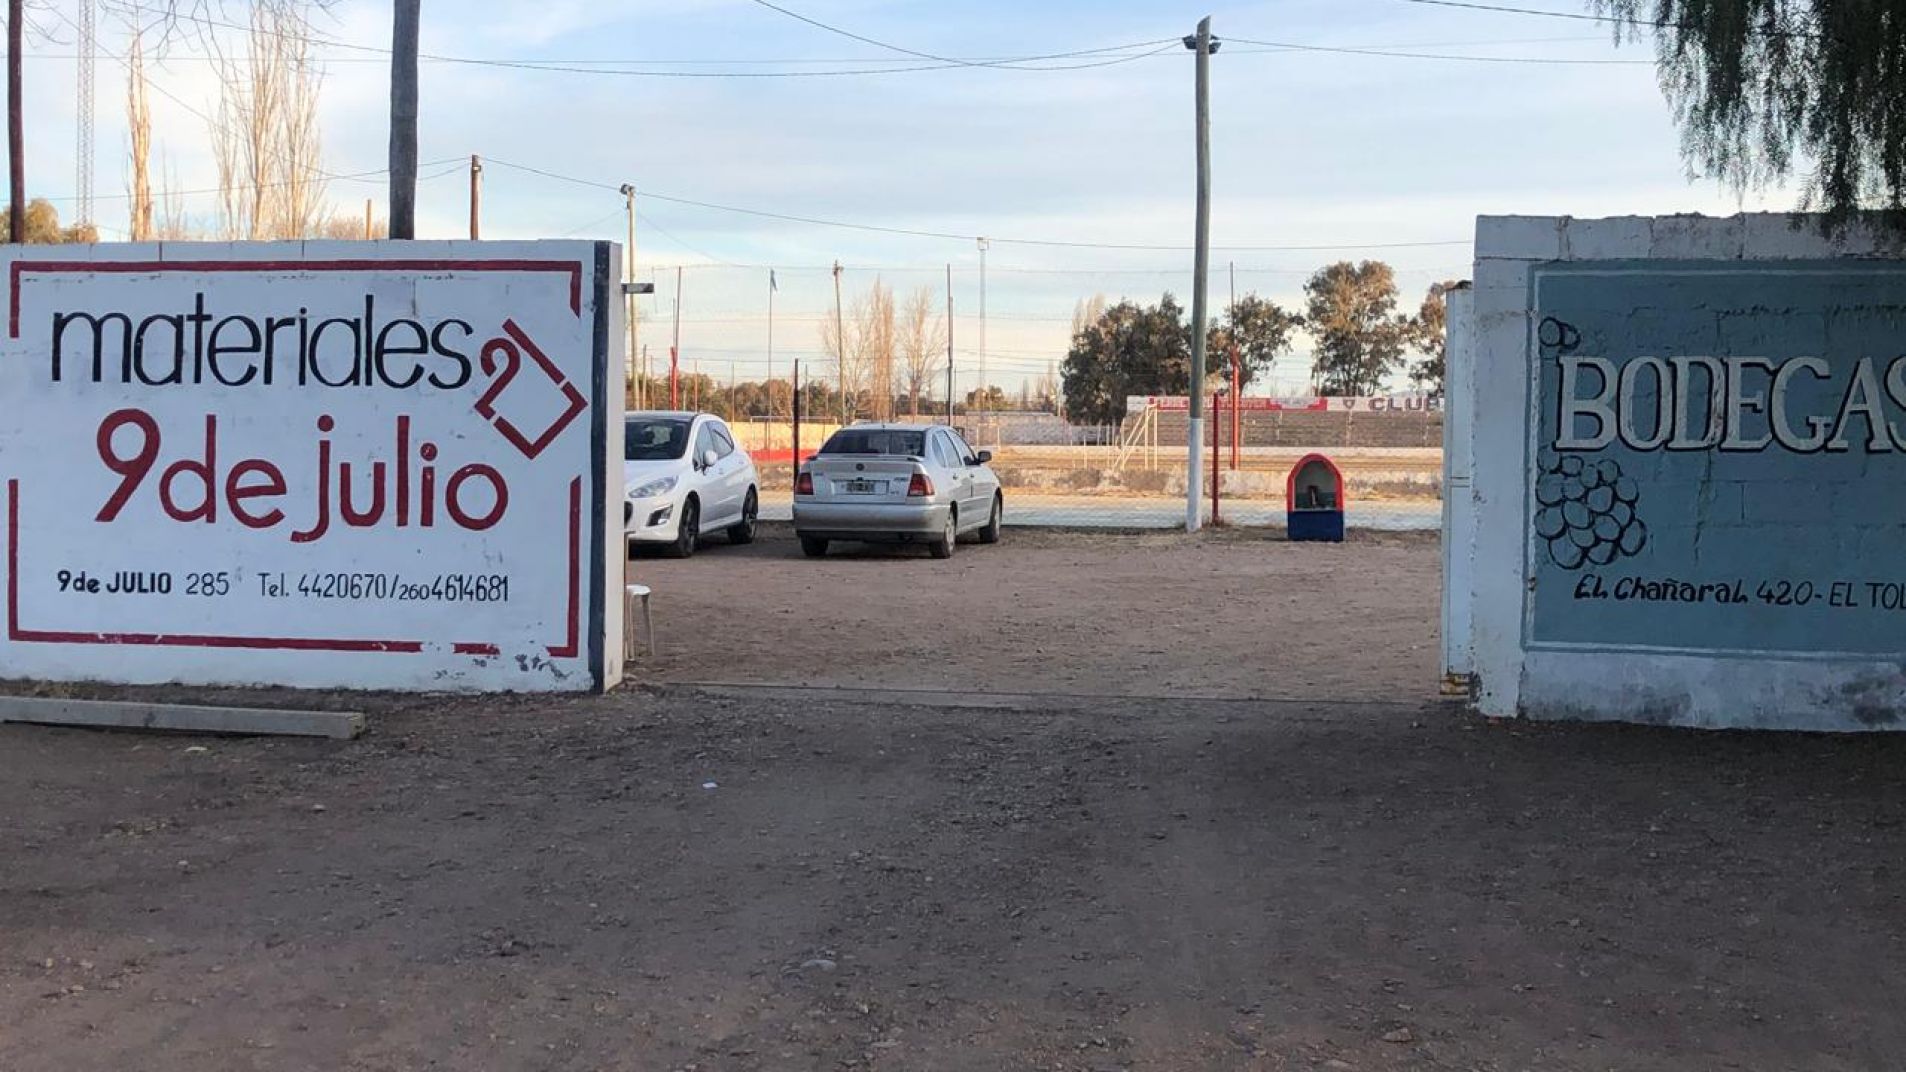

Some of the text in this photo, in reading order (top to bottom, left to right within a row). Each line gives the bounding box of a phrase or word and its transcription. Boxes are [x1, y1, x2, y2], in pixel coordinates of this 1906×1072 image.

[52, 293, 473, 389] materiales
[290, 414, 509, 542] julio
[106, 571, 172, 594] JULIO
[185, 572, 230, 597] 285
[257, 572, 290, 598] Tel.
[1830, 582, 1858, 607] EL
